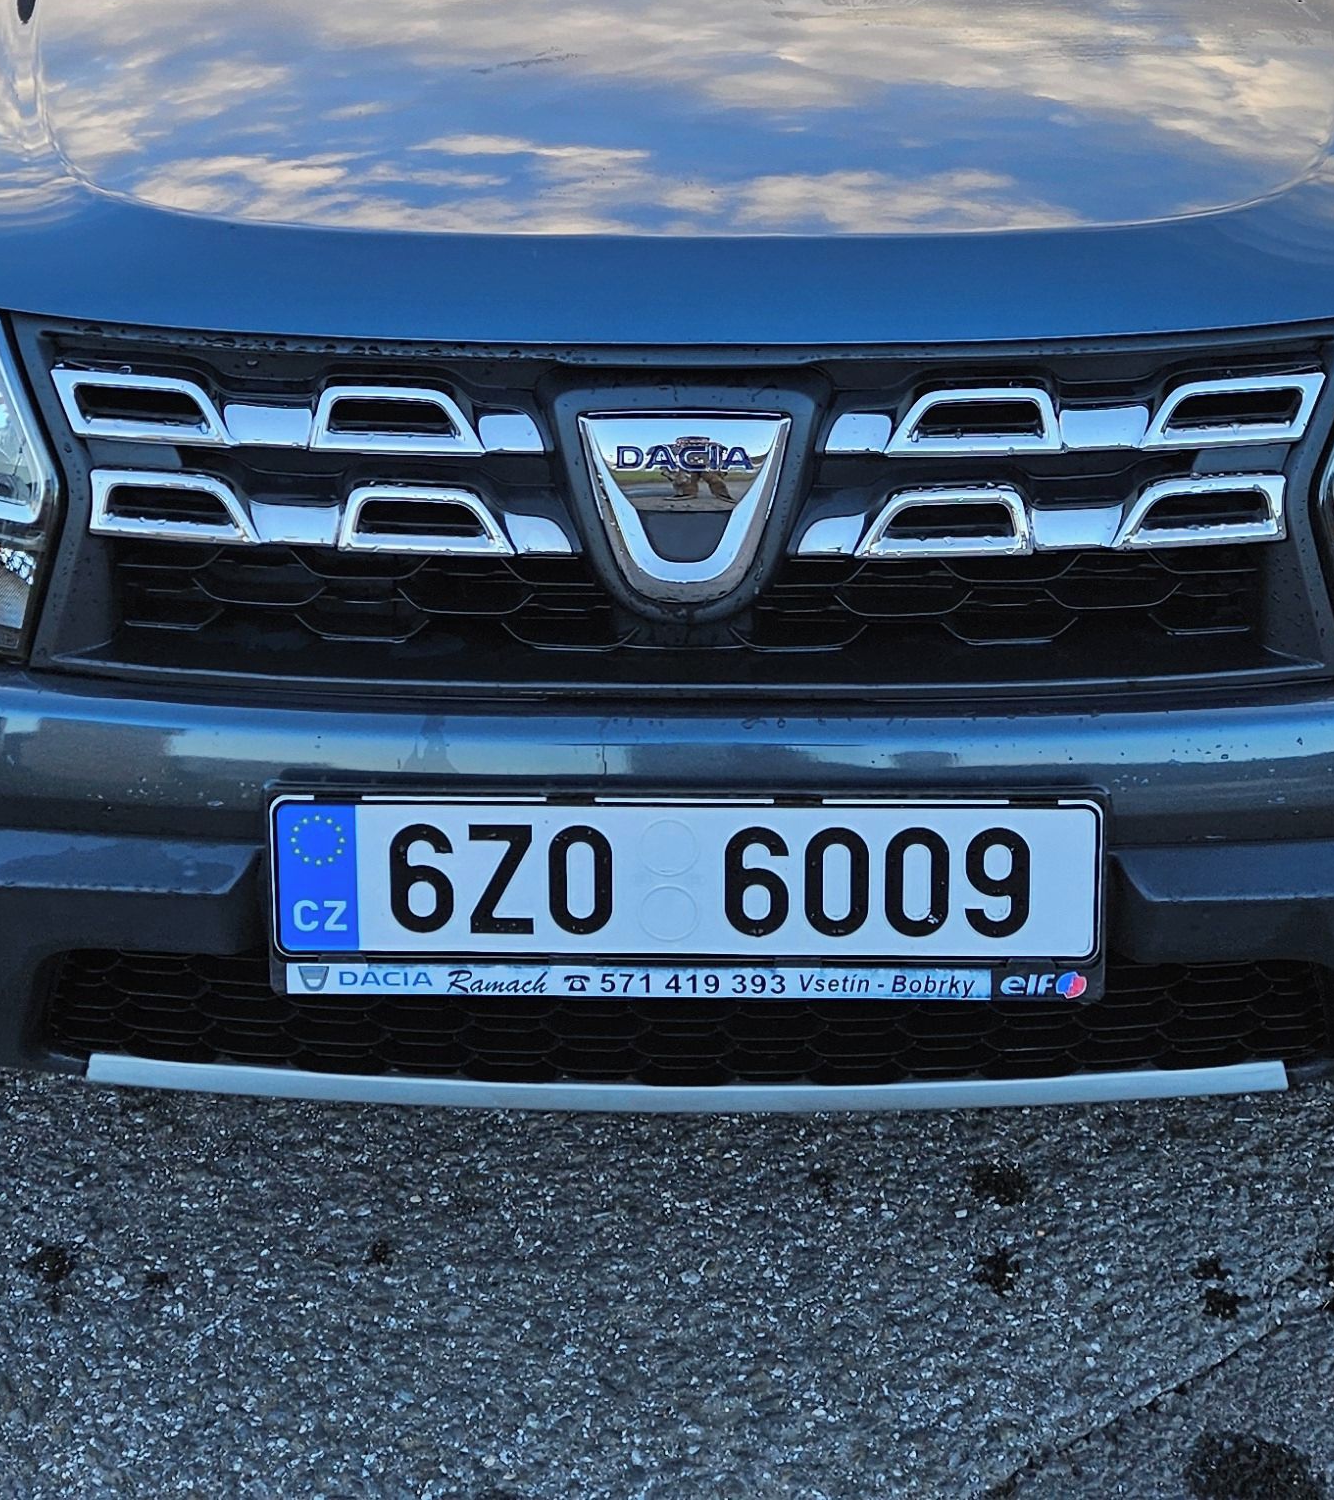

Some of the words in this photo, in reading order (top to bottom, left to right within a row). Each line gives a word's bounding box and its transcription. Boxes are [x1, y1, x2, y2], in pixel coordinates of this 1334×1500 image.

[616, 445, 754, 472] DACIA
[292, 899, 348, 933] CZ
[389, 823, 613, 936] 6Z0
[723, 825, 1031, 939] 6009
[338, 970, 433, 987] DACIA
[446, 969, 548, 995] Ramach
[599, 973, 651, 994] 571
[664, 974, 721, 994] 419
[730, 974, 787, 995] 393
[798, 973, 871, 994] Vsetín
[890, 974, 976, 1000] Bobrky
[999, 973, 1058, 996] elf
